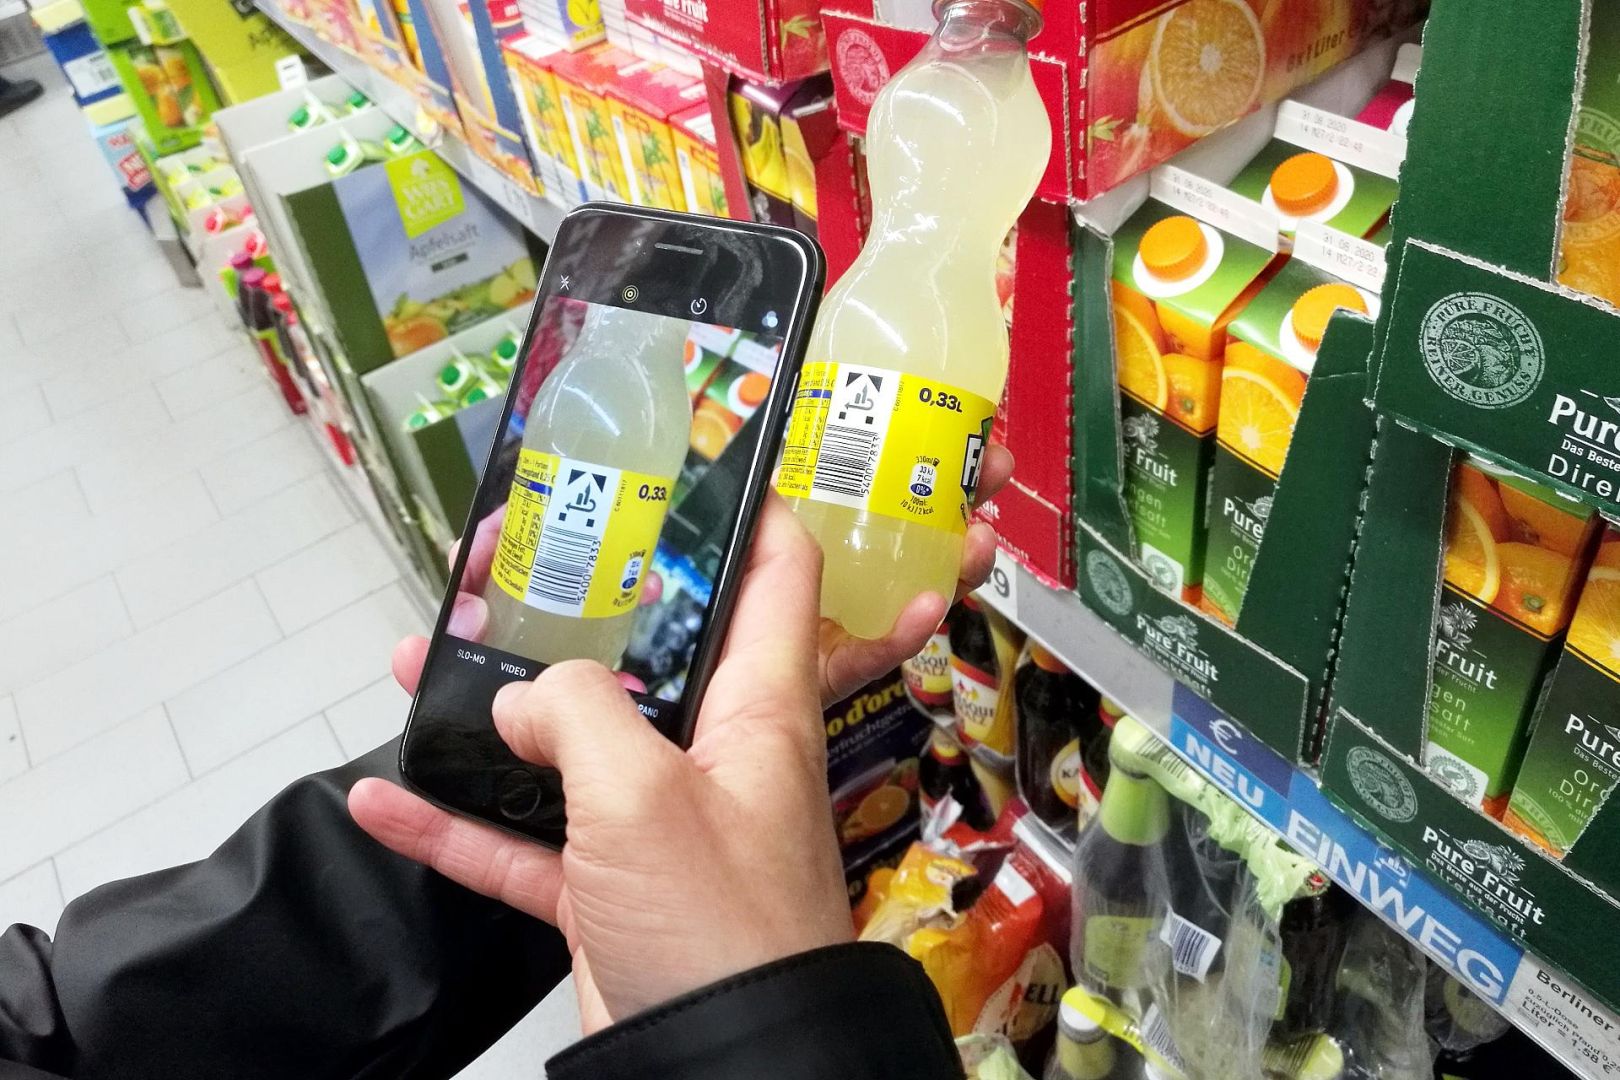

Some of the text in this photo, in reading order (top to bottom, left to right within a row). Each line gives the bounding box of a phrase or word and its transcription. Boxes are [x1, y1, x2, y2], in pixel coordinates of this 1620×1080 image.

[1436, 298, 1539, 360] PURE FRUCHT
[1471, 369, 1533, 404] GENUSS
[1136, 448, 1179, 487] Fruit
[1561, 438, 1584, 458] Das
[1548, 453, 1620, 503] Dire
[1223, 497, 1264, 540] Pure
[456, 648, 486, 666] SLO-MO
[500, 661, 527, 678] VIDEO
[1136, 612, 1174, 650] Pure
[1177, 641, 1220, 682] Fruit
[1435, 637, 1498, 690] Fruit
[1564, 713, 1620, 768] Pure
[1573, 746, 1591, 763] Das
[1185, 732, 1266, 809] NEU
[1422, 825, 1546, 926] Pure Fruit
[1431, 851, 1525, 926] Das Beste aus der Frucht
[1286, 808, 1507, 1003] EINWEG
[1536, 969, 1615, 1032] Berliner
[1521, 1000, 1556, 1029] Liter
[1571, 1038, 1600, 1065] 1.58
[1571, 1031, 1602, 1056] Pfand
